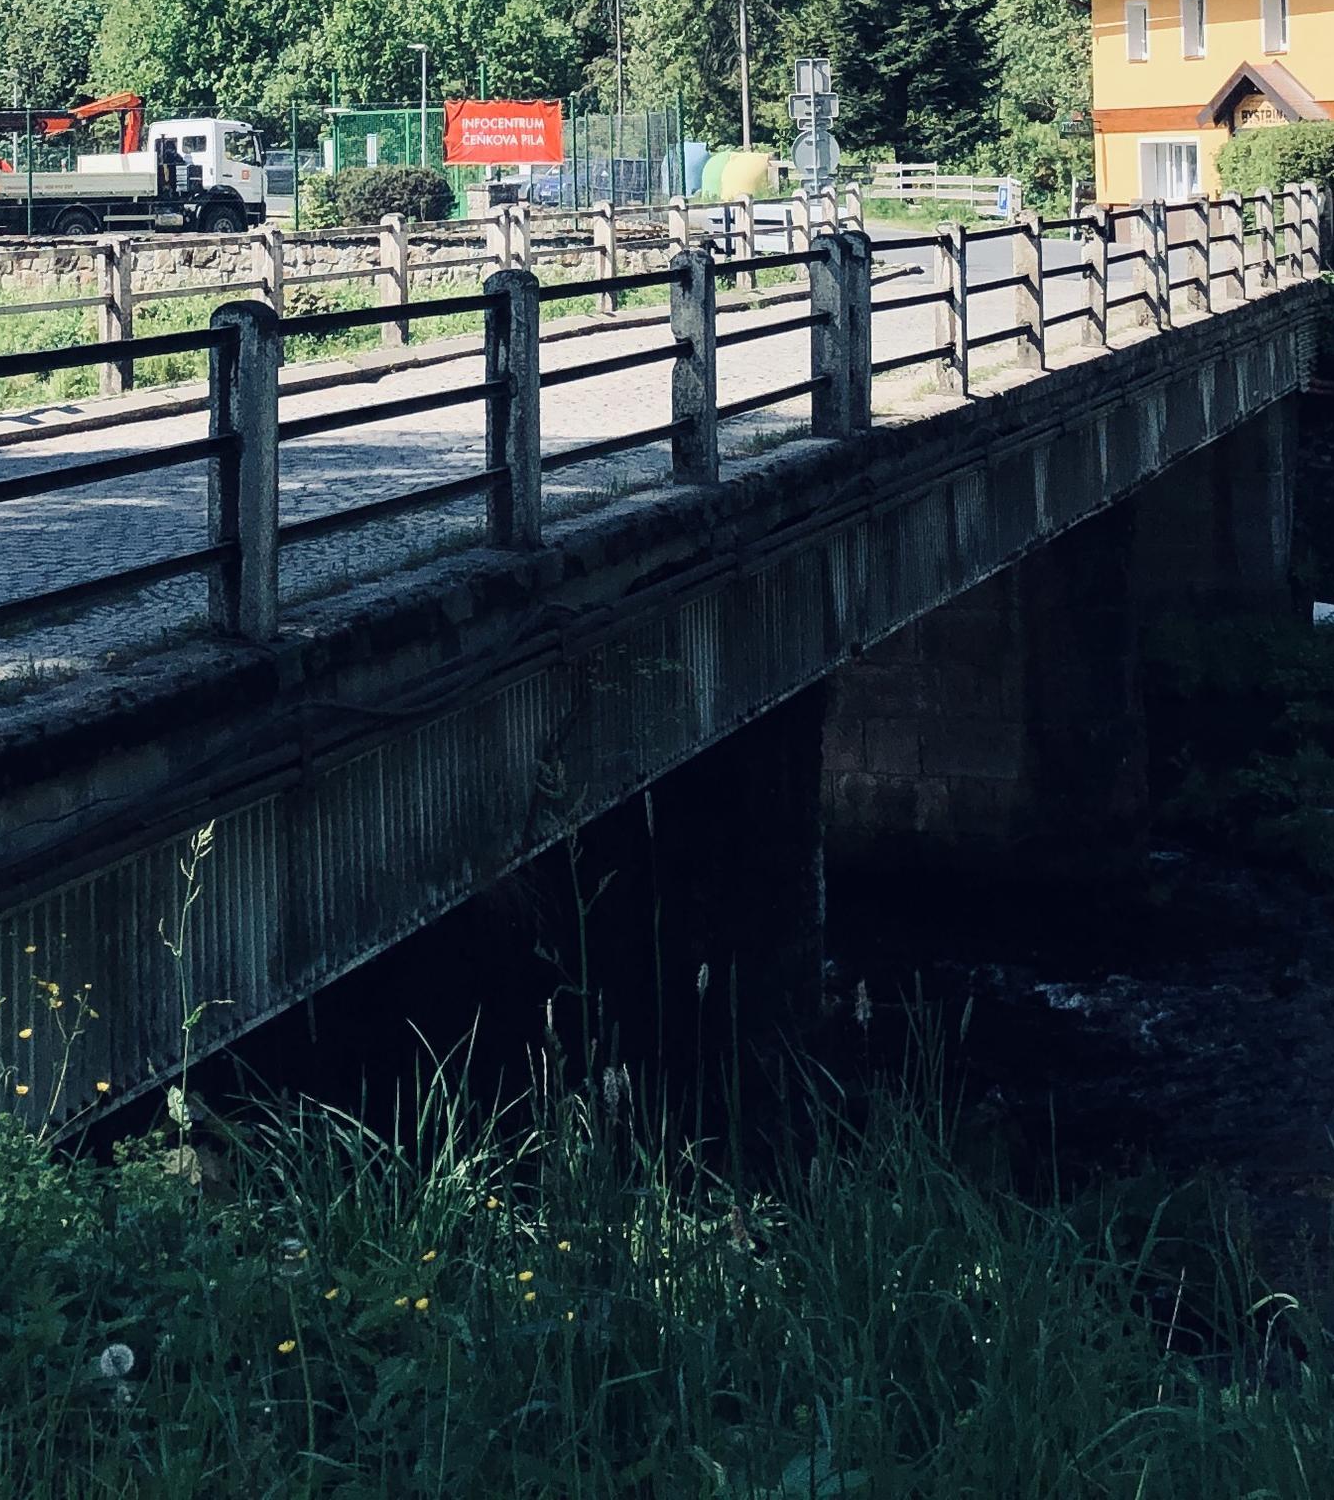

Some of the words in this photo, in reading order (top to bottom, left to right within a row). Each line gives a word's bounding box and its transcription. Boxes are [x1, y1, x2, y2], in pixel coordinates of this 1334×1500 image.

[462, 117, 545, 130] INFOCENTRUM
[462, 131, 518, 146] ČEŇKOVA
[521, 134, 545, 146] PILA
